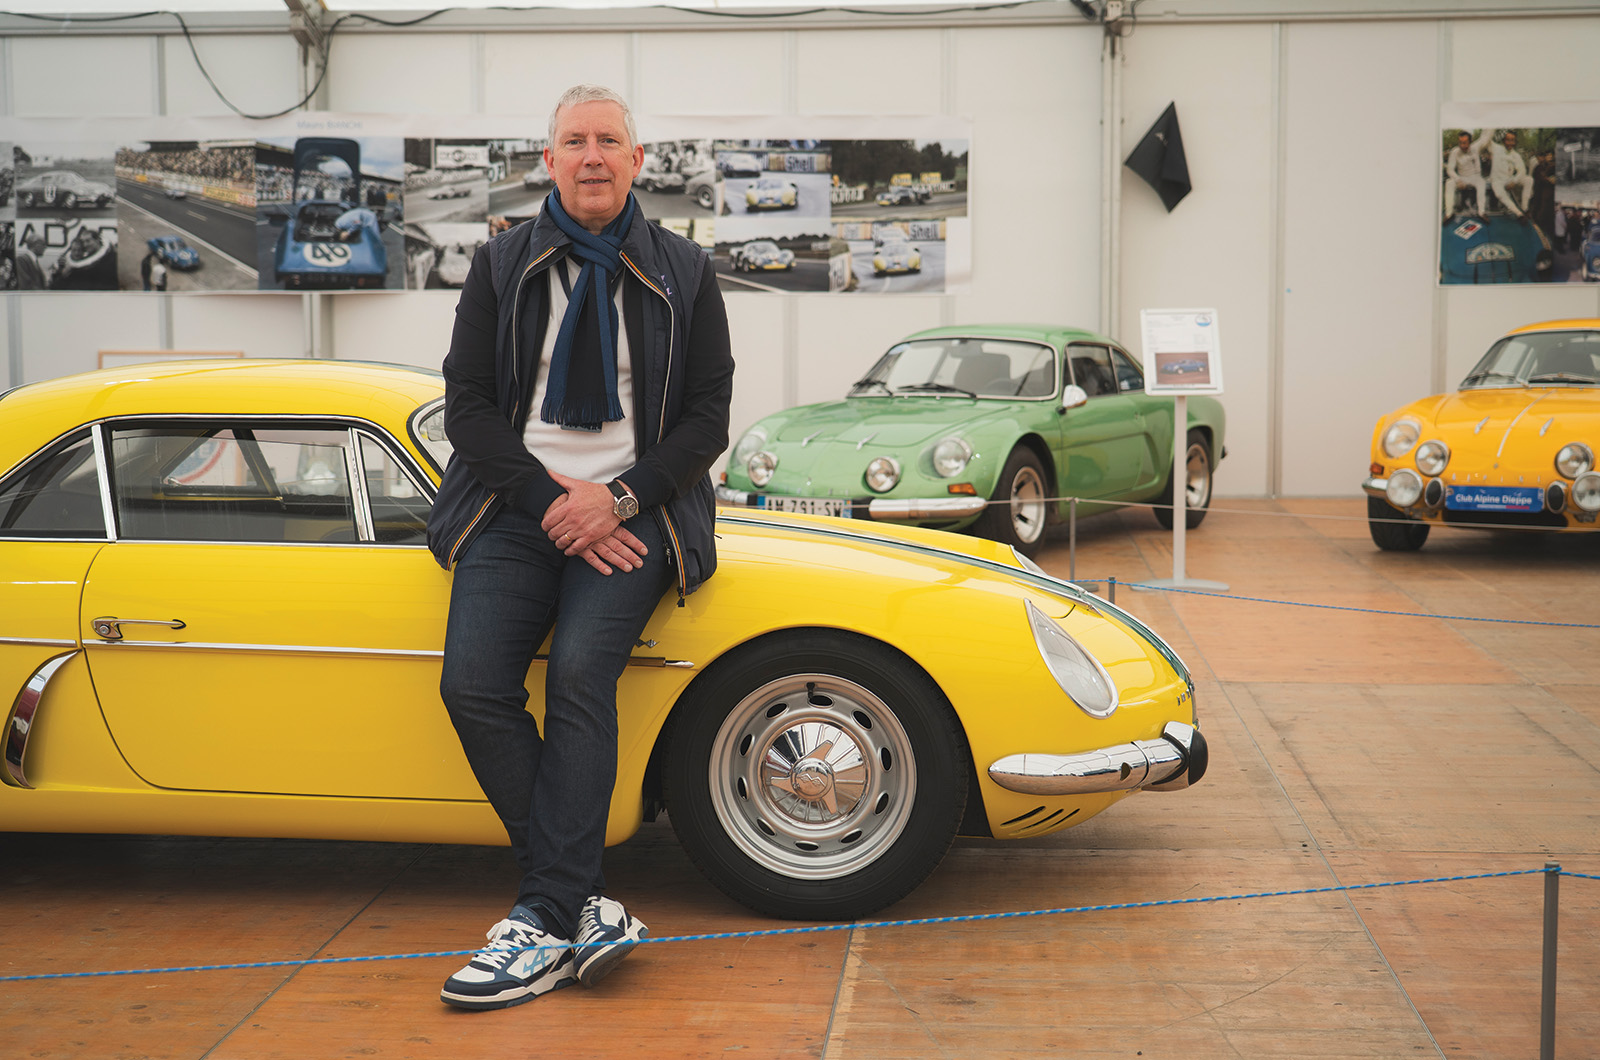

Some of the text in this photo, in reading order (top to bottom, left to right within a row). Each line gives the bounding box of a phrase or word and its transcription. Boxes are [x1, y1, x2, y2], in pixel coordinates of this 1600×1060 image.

[787, 155, 815, 172] Shell
[910, 224, 938, 240] Shell
[1455, 494, 1533, 506] Club Alpine Dieppe
